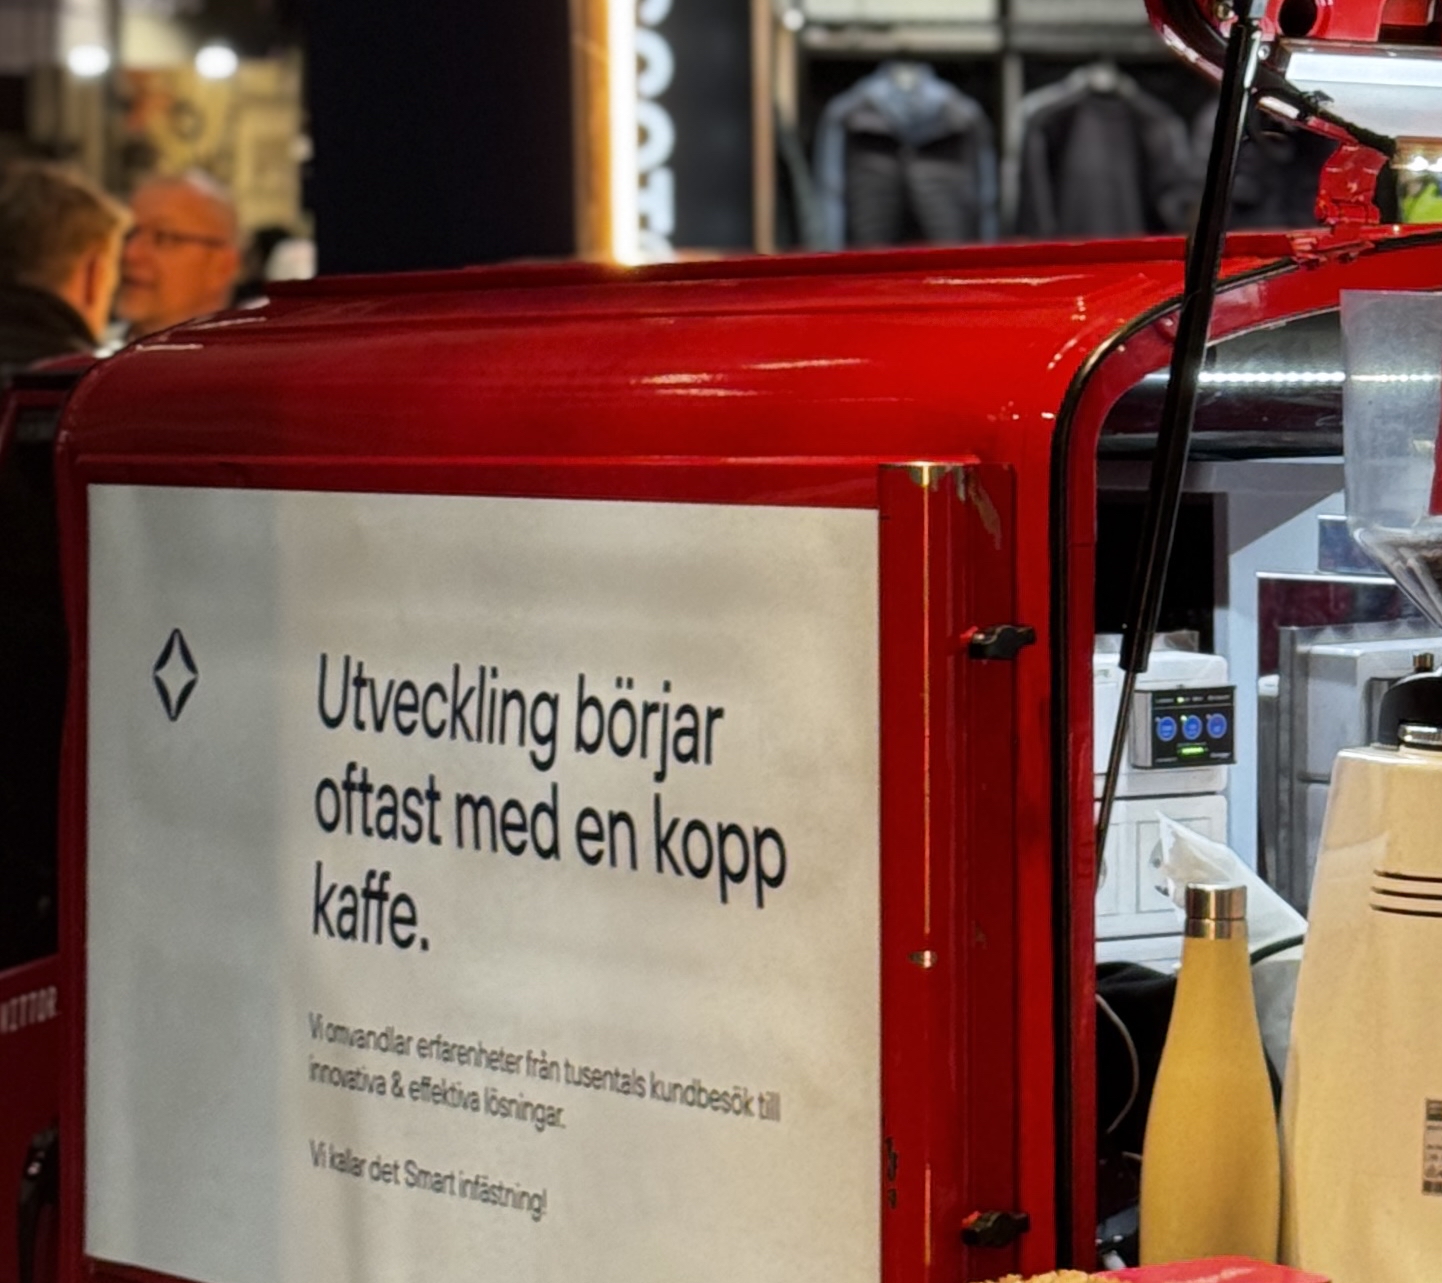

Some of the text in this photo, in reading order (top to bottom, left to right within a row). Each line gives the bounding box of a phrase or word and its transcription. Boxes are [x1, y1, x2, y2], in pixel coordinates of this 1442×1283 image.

[318, 652, 724, 782] Utveckling börjar
[315, 761, 787, 909] oftast med en kopp
[313, 860, 429, 951] kaffe.
[309, 1012, 781, 1122] Vi omvandlar erfarenheter från tusentals kundbesök till
[309, 1054, 386, 1095] innovativa
[391, 1070, 405, 1098] &
[408, 1076, 480, 1112] effektiva
[310, 1140, 326, 1167] Vi
[368, 1155, 401, 1185] det
[404, 1159, 456, 1196] Smart
